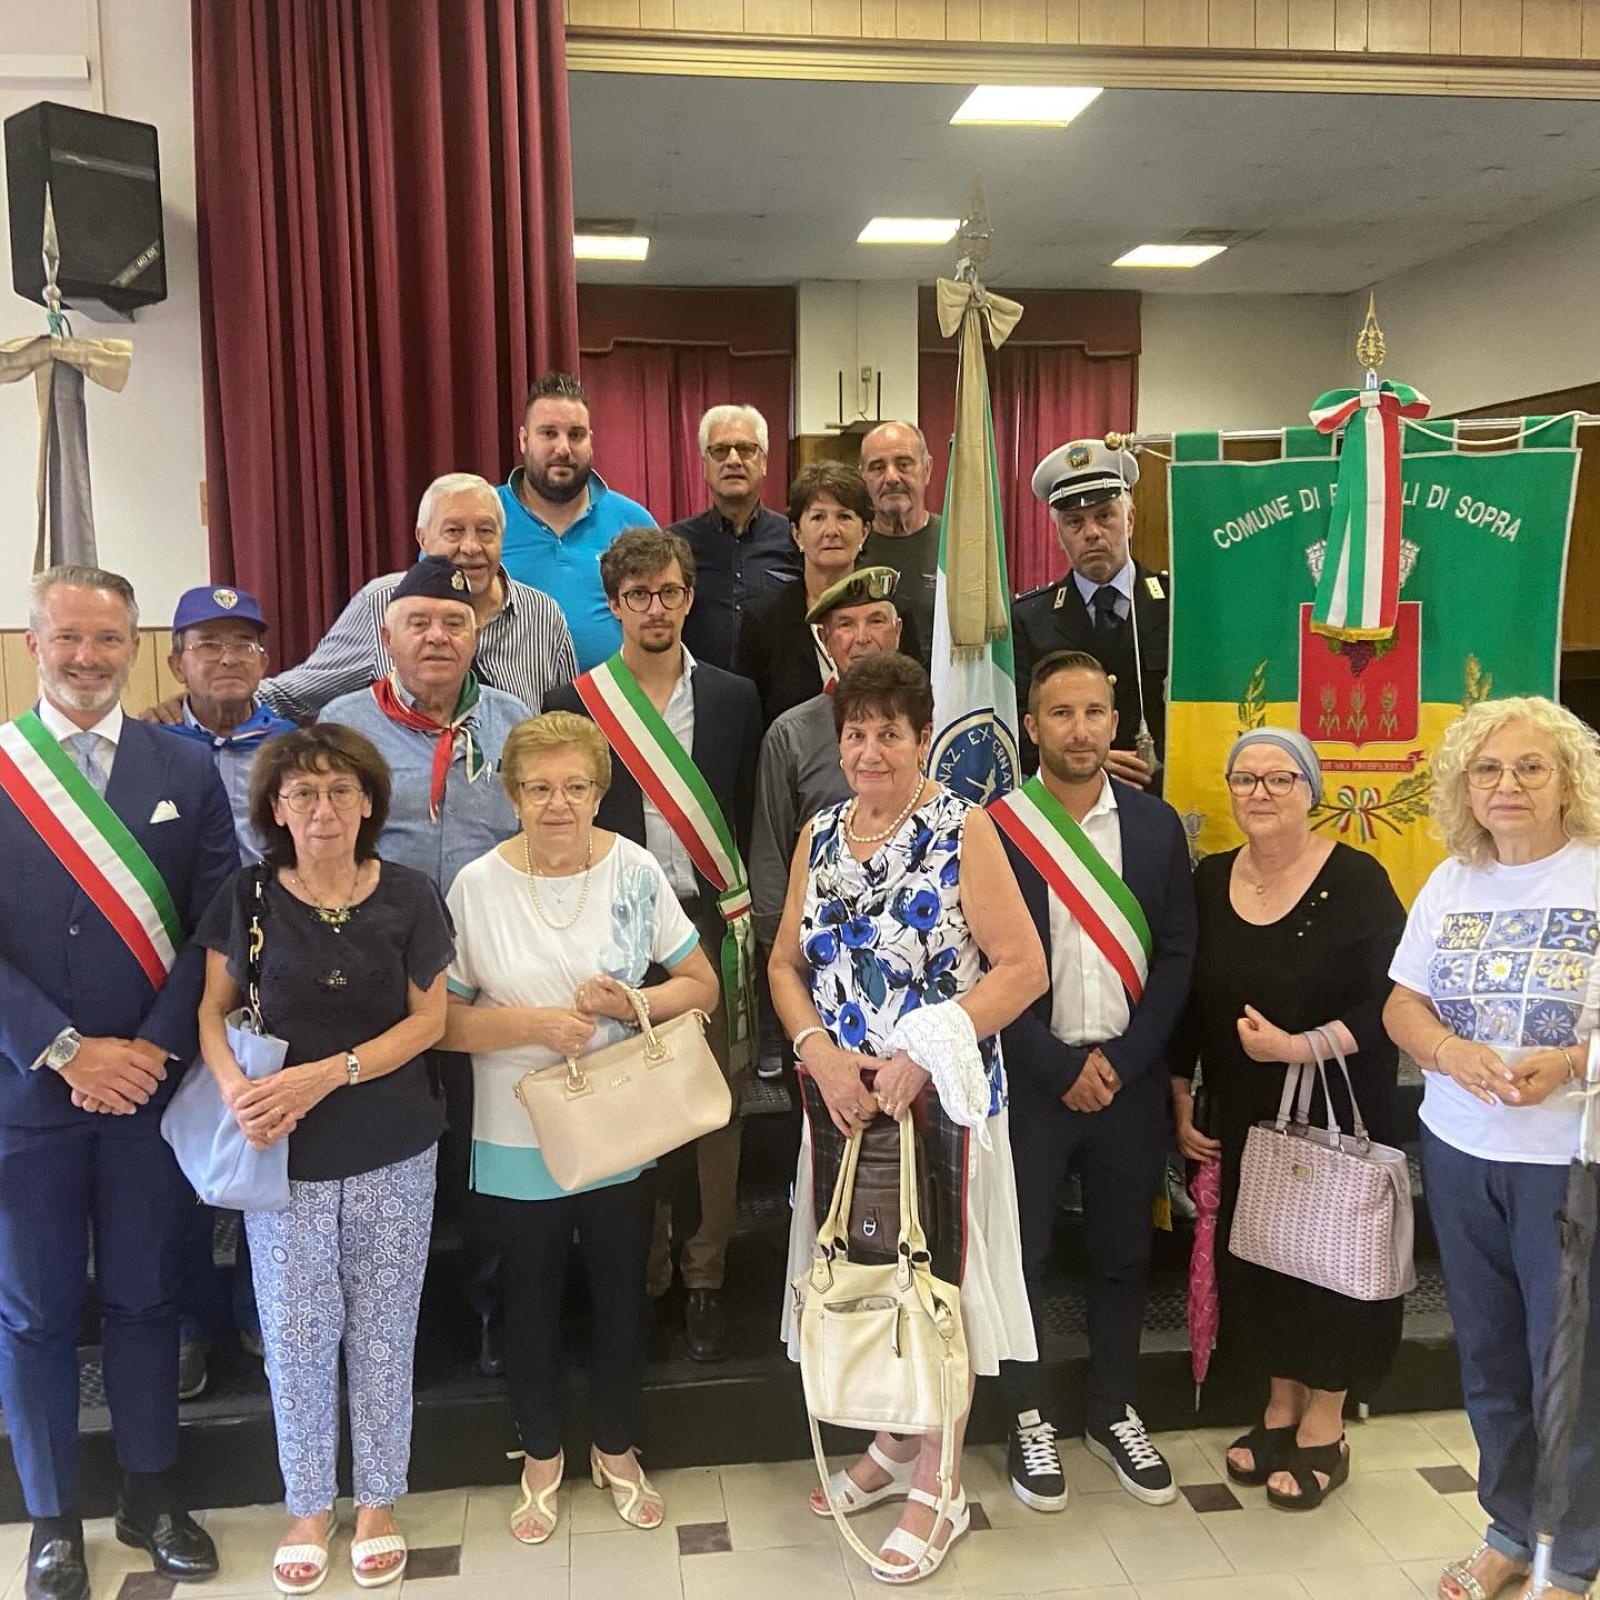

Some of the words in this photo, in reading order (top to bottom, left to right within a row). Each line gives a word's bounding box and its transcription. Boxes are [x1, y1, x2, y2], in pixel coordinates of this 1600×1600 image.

[1213, 495, 1293, 549] COMUNE
[1298, 486, 1320, 512] DI
[1426, 484, 1450, 510] DI
[1455, 495, 1522, 542] SOPRA
